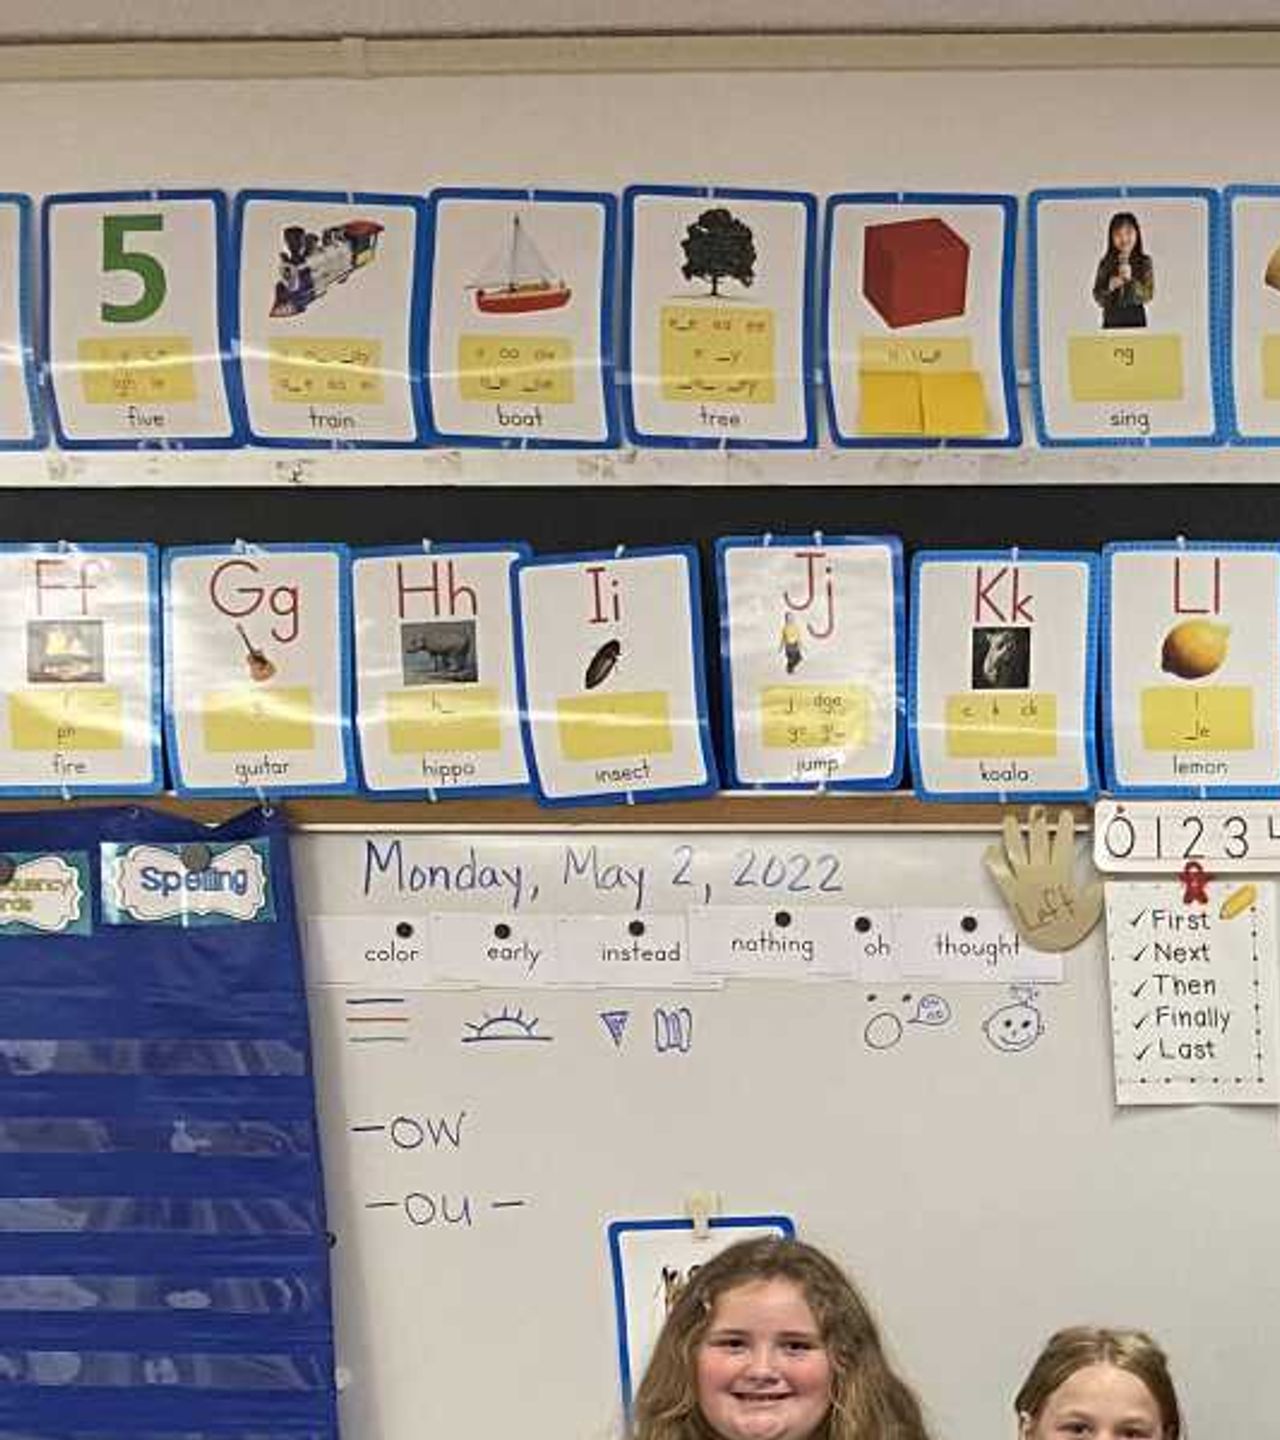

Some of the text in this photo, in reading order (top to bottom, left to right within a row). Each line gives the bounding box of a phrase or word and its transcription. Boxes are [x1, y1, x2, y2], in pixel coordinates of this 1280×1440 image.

[99, 211, 169, 324] 5
[1113, 345, 1135, 365] ng
[126, 406, 165, 428] five
[309, 406, 356, 429] train
[497, 404, 543, 427] boat
[699, 405, 740, 427] tree
[1109, 410, 1151, 434] sing
[35, 558, 112, 616] Ff
[397, 560, 478, 618] Hh
[585, 566, 621, 624] Ii
[784, 551, 834, 639] Jj
[974, 566, 1034, 624] Kk
[209, 558, 301, 643] Gg
[53, 754, 87, 774] fire
[235, 756, 291, 787] guitar
[422, 757, 477, 784] hippo
[595, 760, 651, 783] insect
[796, 757, 840, 780] jump
[979, 761, 1029, 784] koala
[1172, 755, 1228, 776] lemon
[1181, 816, 1205, 858] 2
[1222, 816, 1250, 858] 3
[140, 865, 249, 897] Spelling
[364, 838, 845, 912] Monday, May 2, 2022
[1151, 908, 1212, 931] First
[364, 944, 419, 963] color
[486, 943, 541, 973] early
[601, 941, 682, 963] instead
[731, 935, 815, 962] nothing
[863, 934, 891, 957] oh
[1153, 942, 1211, 963] Next
[1156, 975, 1217, 996] Then
[1156, 1007, 1231, 1038] Finally
[1158, 1039, 1217, 1060] Last
